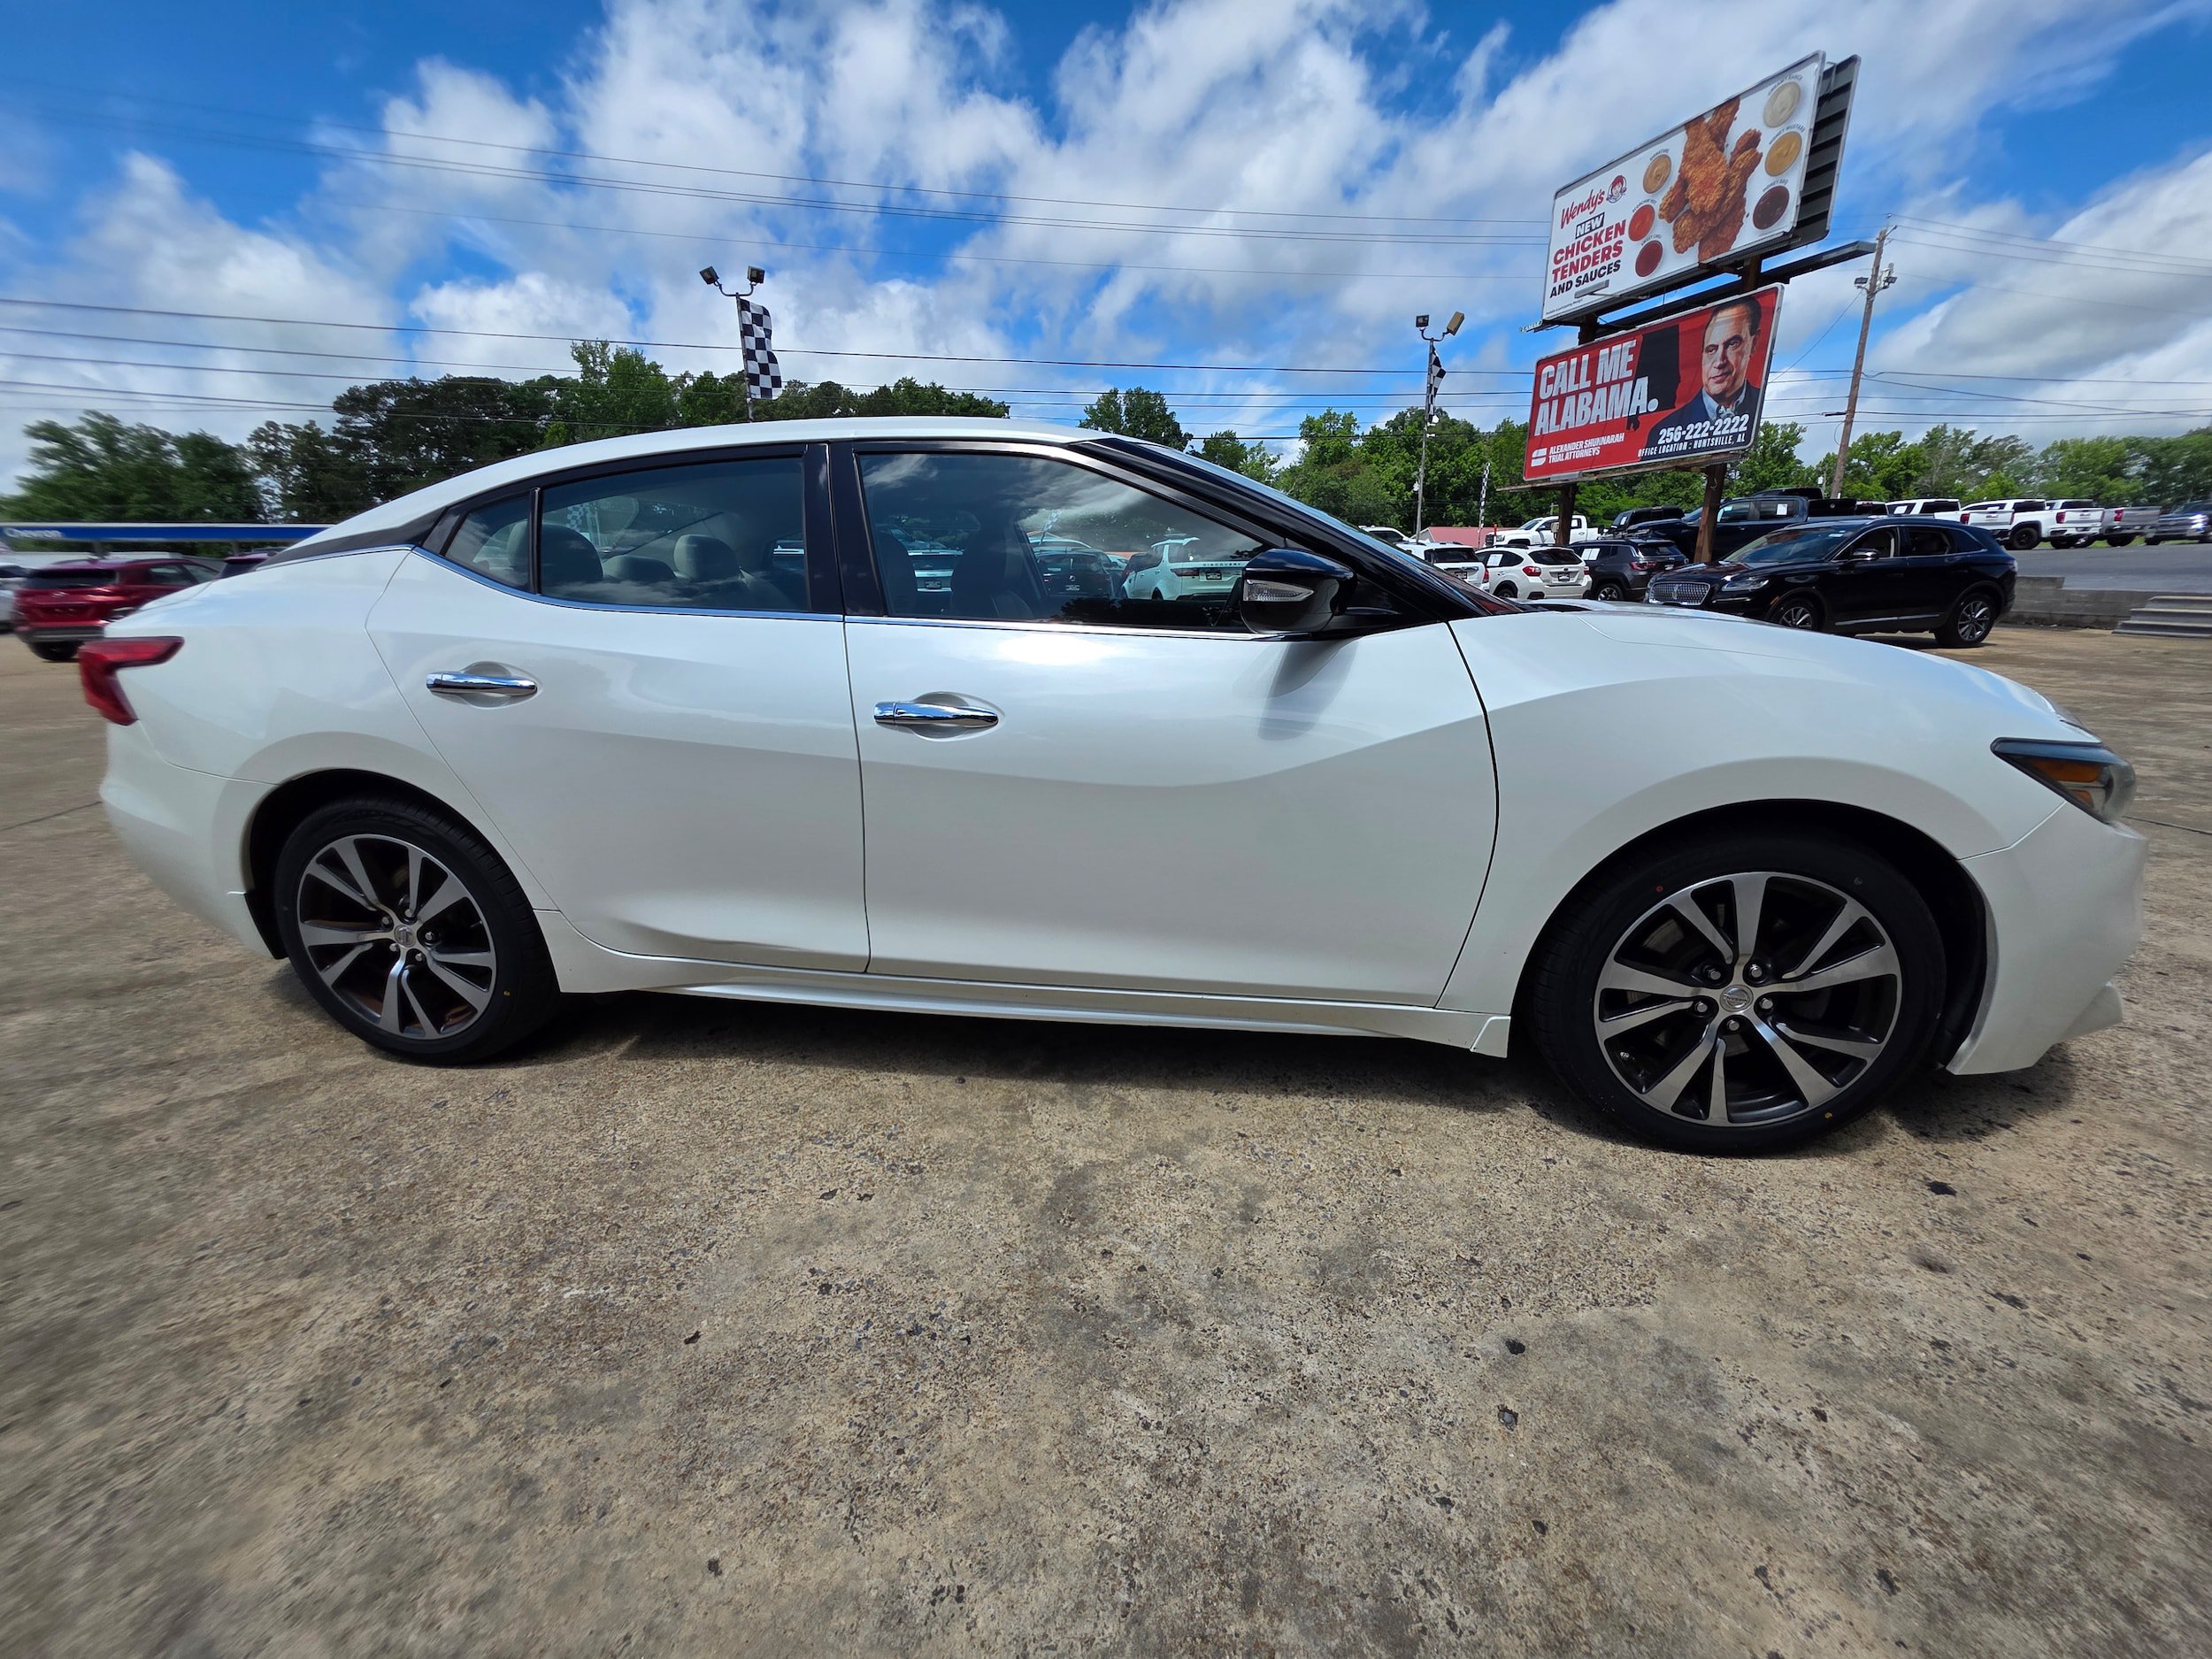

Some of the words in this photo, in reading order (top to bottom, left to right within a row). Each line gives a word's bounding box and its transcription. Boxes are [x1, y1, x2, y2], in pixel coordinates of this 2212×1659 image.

[1560, 188, 1605, 229] Wendy's
[1576, 213, 1604, 238] NEW
[1551, 240, 1624, 283] TENDERS
[1553, 219, 1626, 265] CHICKEN
[1549, 280, 1573, 298] AND
[1575, 259, 1621, 288] SAUCES
[1540, 354, 1591, 400] CALL
[1596, 339, 1637, 385] ME
[1534, 376, 1659, 436] ALABAMA.
[1548, 441, 1584, 455] ALEXANDER
[1584, 433, 1624, 448] SHUNNARAH
[1638, 446, 1657, 457] OFFICE
[1658, 442, 1687, 454] LOCATION
[1693, 435, 1734, 449] HUNTSVILLE,
[1736, 433, 1745, 442] AL
[1657, 414, 1749, 445] 256-222-2222
[1548, 454, 1564, 464] TRIAL
[1564, 447, 1601, 460] ATTORNEYS
